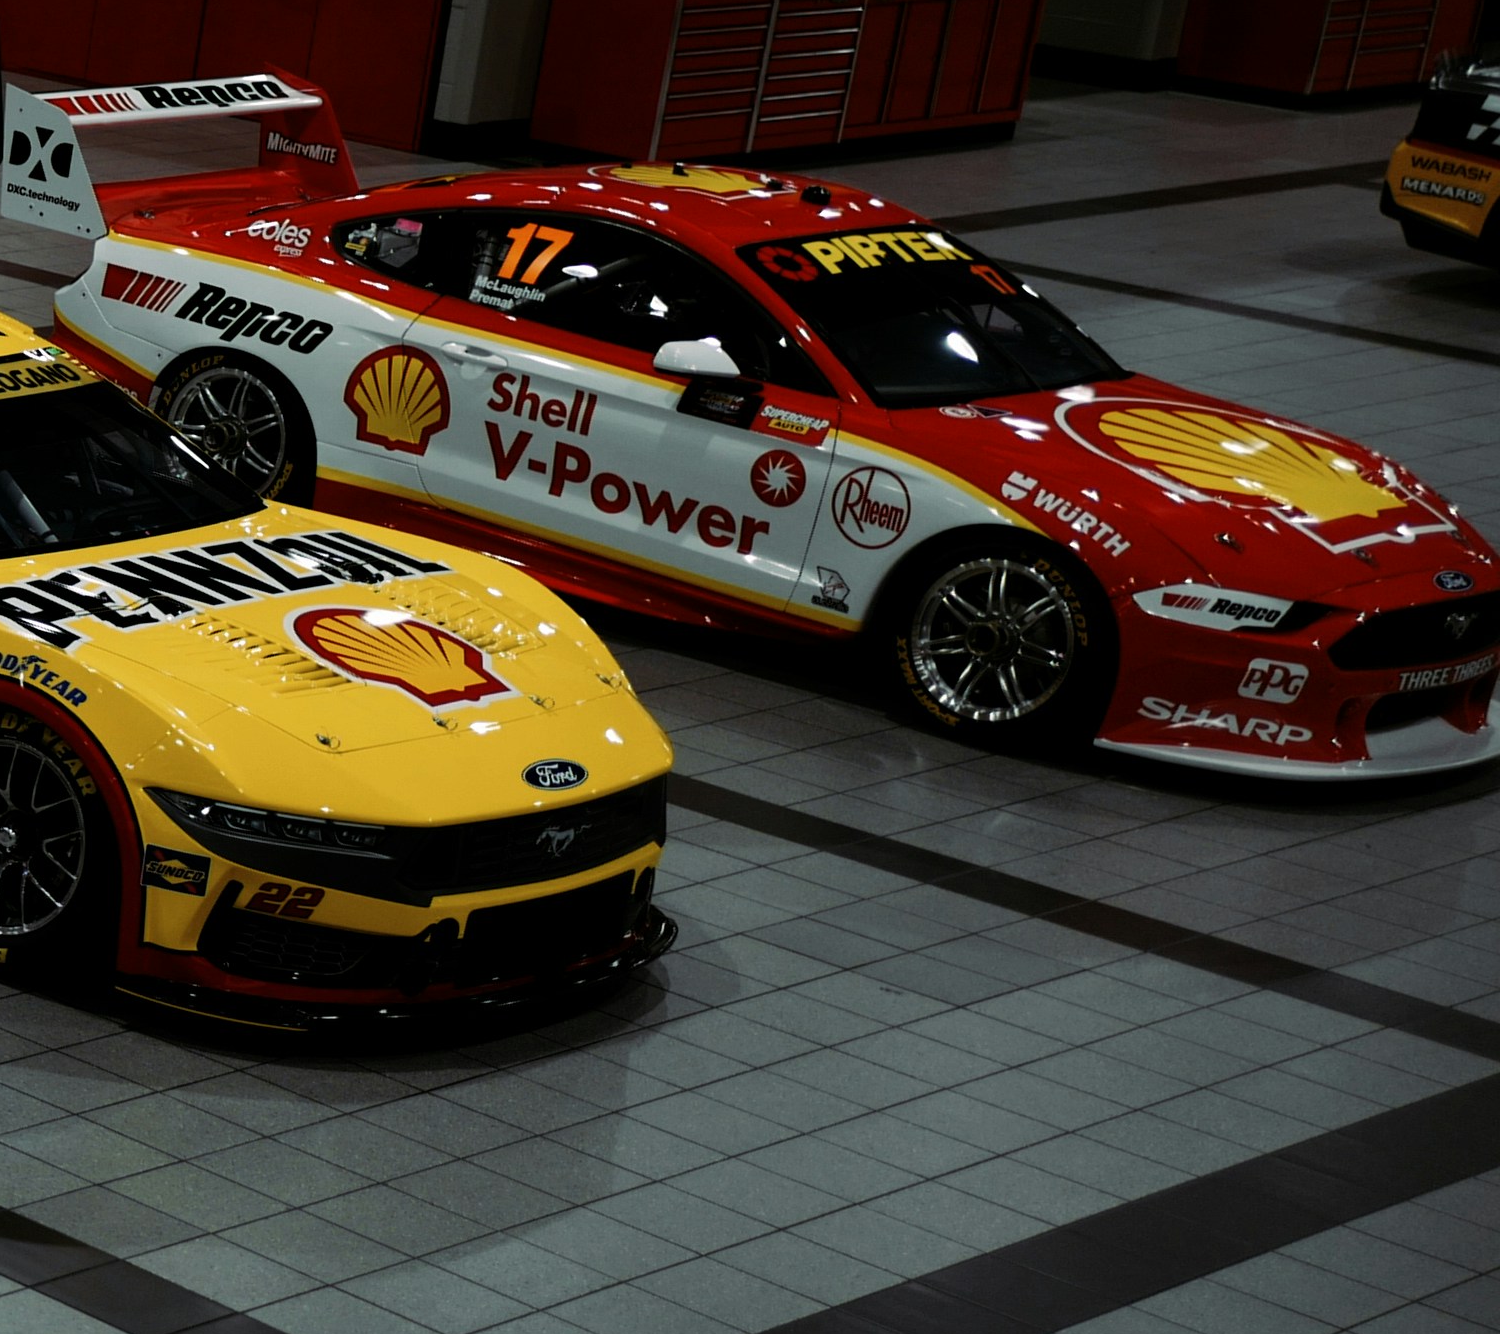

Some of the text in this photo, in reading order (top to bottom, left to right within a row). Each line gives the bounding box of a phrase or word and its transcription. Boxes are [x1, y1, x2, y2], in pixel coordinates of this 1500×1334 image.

[134, 79, 290, 110] Repco
[1410, 156, 1493, 183] WABASH
[6, 181, 81, 212] DXC.technology
[1401, 177, 1487, 206] MENARDS
[247, 217, 312, 249] coles
[497, 222, 576, 286] 17
[802, 231, 974, 276] PIRTEK
[468, 288, 515, 312] Premat
[474, 273, 546, 304] McLaughlin
[175, 281, 334, 356] Repco
[161, 354, 226, 405] DUNLOP
[487, 372, 598, 436] Shell
[760, 404, 830, 432] SUPERCHEAP
[773, 420, 806, 433] AUTO
[485, 420, 771, 556] V-Power
[840, 471, 906, 536] Rheem
[1031, 489, 1133, 560] WÜRTH
[1438, 572, 1468, 591] Ford
[1033, 559, 1090, 649] DUNLOP
[1212, 599, 1285, 625] Repco
[1243, 663, 1304, 699] PPG
[1398, 668, 1449, 692] THREE
[910, 687, 963, 730] SPORT
[1135, 695, 1313, 748] SHARP
[534, 763, 580, 788] Ford
[146, 859, 209, 884] SUNOCO
[244, 881, 326, 919] 22
